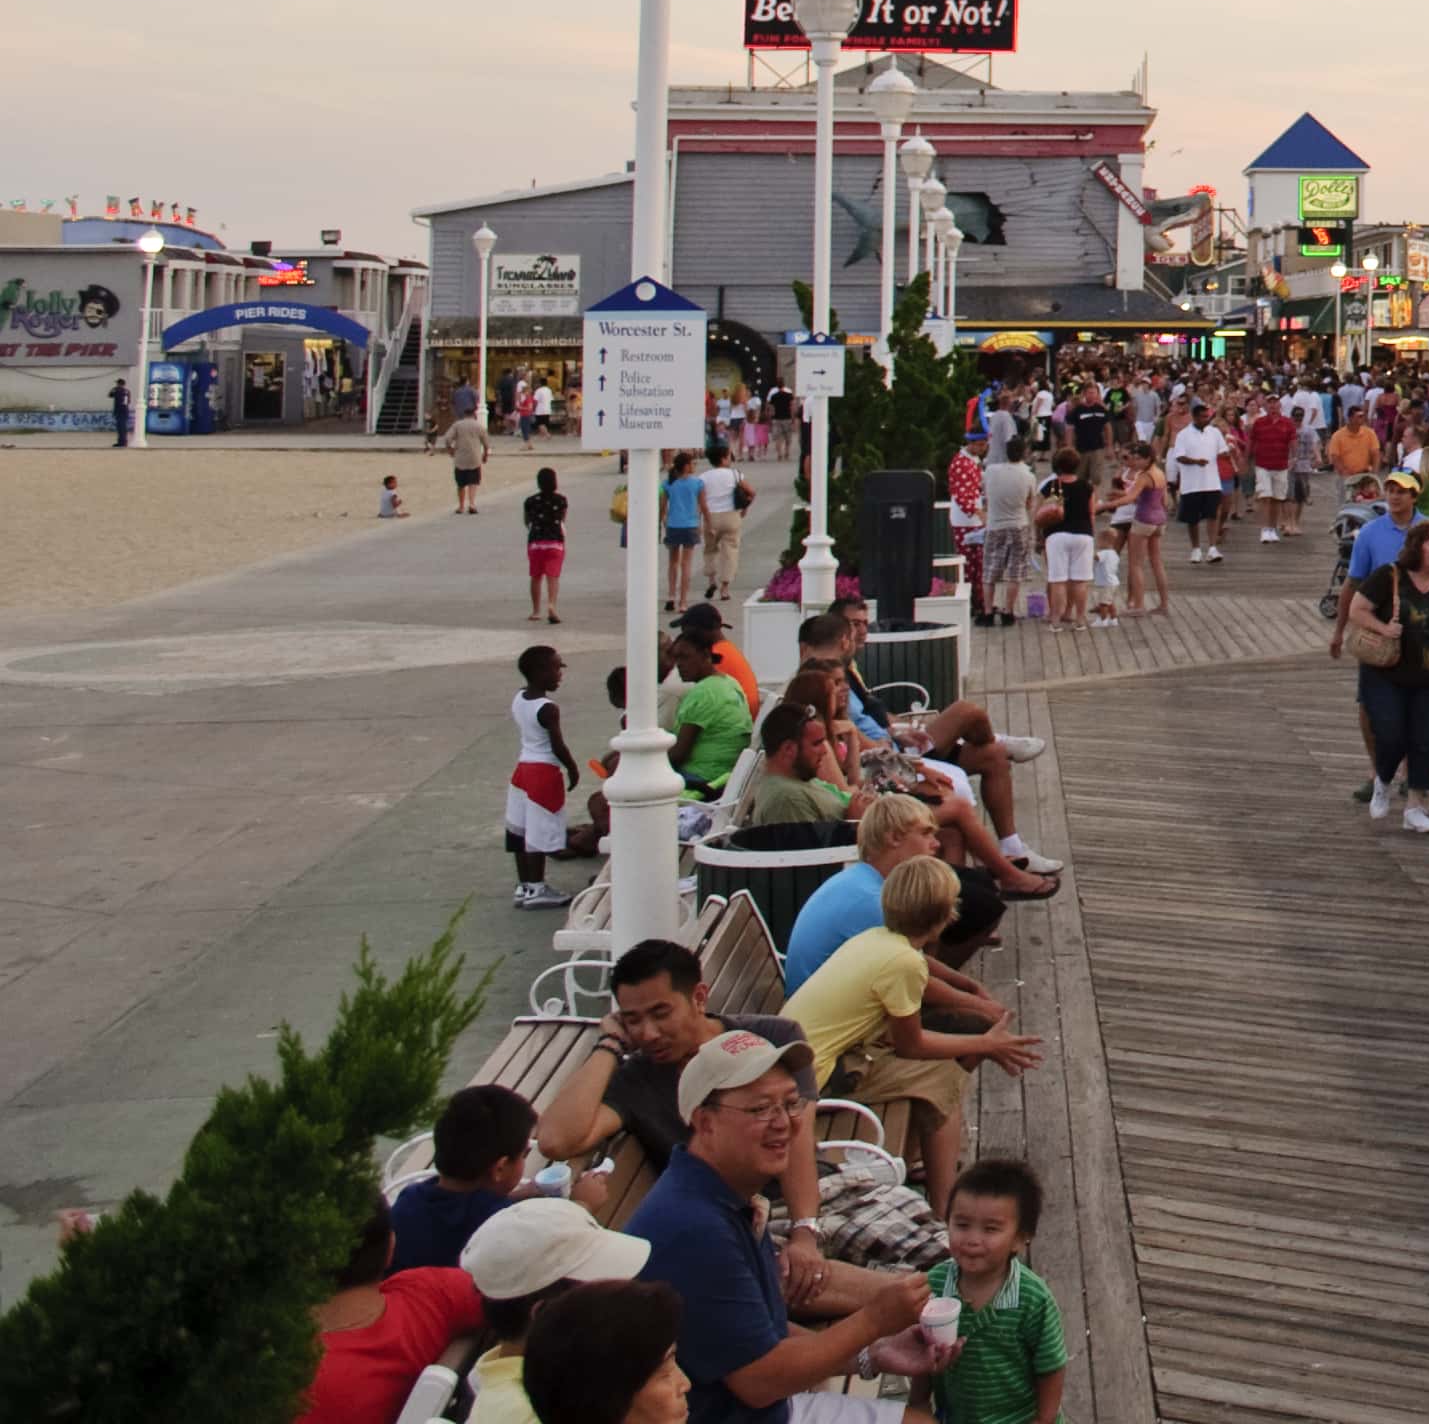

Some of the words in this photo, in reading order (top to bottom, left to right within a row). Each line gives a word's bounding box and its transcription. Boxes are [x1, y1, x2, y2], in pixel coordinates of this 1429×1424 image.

[904, 5, 938, 24] or
[941, 0, 1008, 26] Not!
[18, 290, 77, 316] Jolly
[234, 307, 266, 320] PIER
[268, 306, 307, 320] RIDES
[10, 311, 82, 338] Roger
[599, 321, 668, 337] Worcester
[673, 322, 692, 337] St.
[620, 349, 675, 362] Restroom
[620, 371, 651, 384] Police
[619, 384, 675, 397] Substation
[619, 403, 672, 418] Lifesaving
[618, 417, 664, 430] Museum
